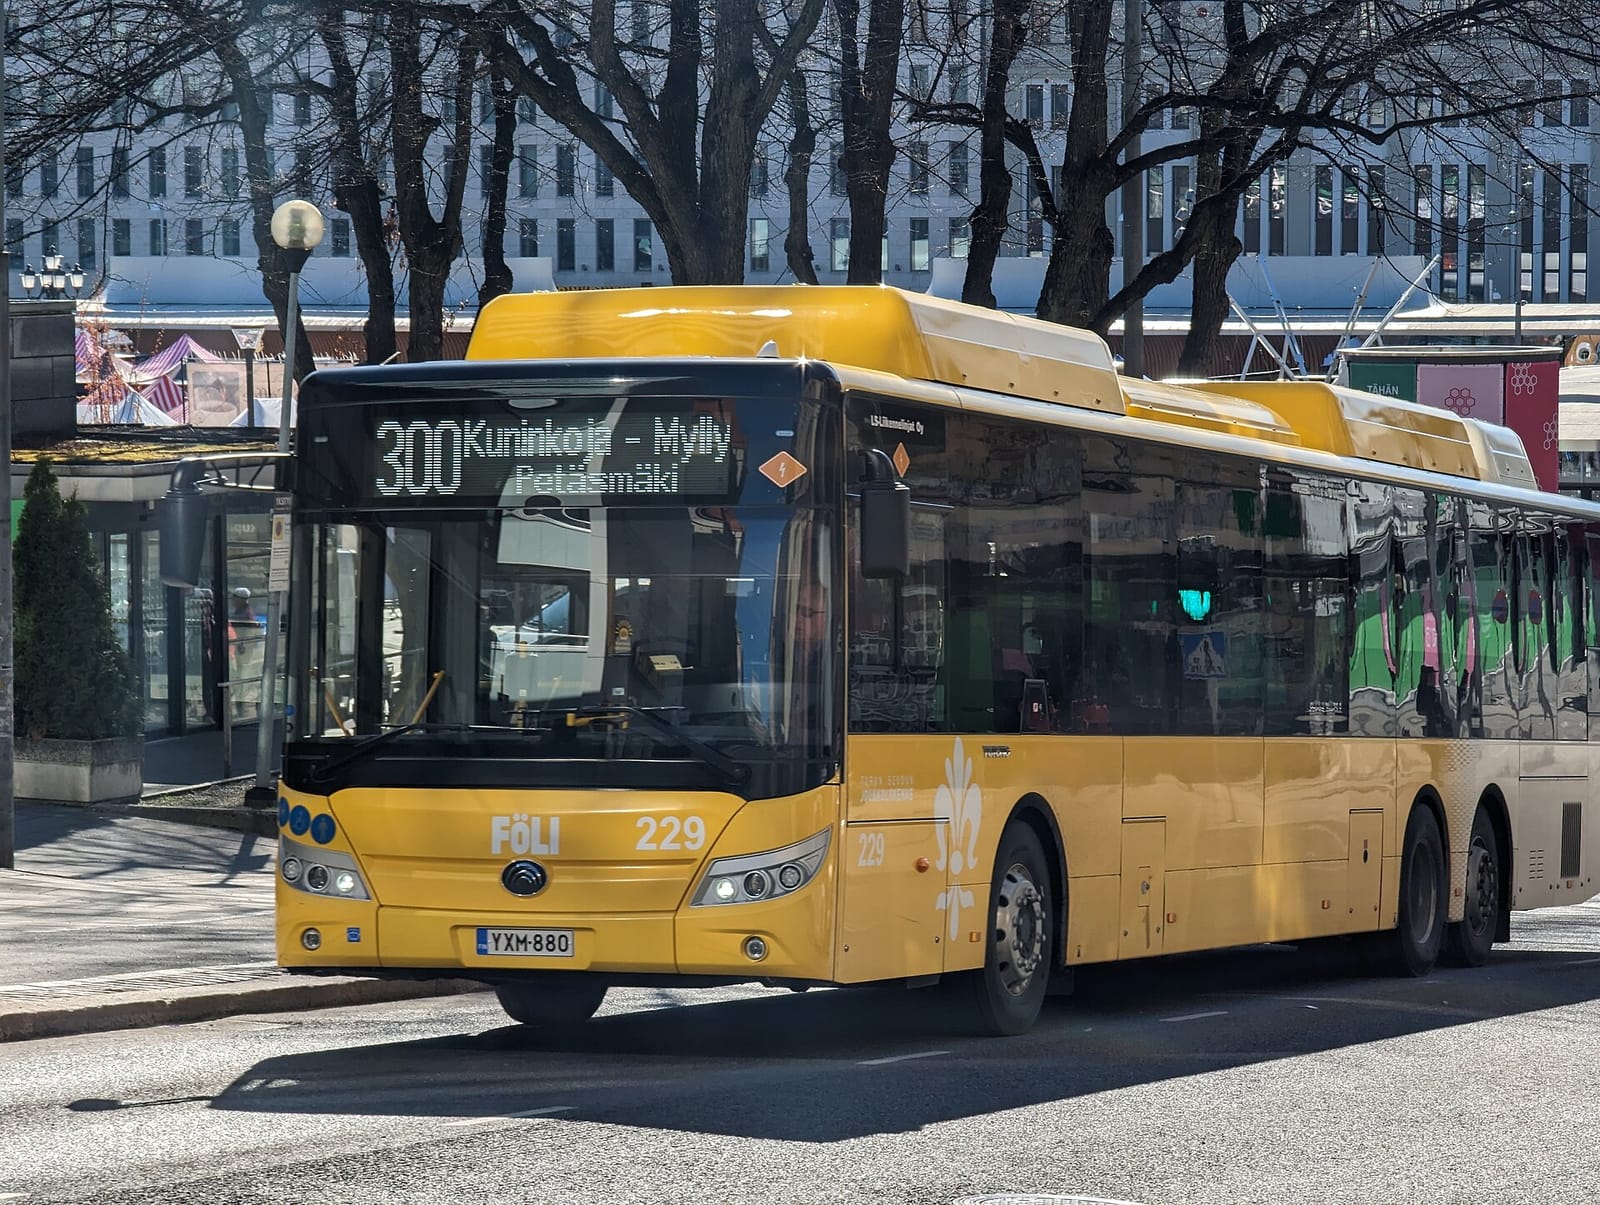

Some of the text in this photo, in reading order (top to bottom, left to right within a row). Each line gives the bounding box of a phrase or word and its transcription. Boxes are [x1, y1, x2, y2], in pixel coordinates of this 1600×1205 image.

[1366, 383, 1399, 396] TÄHÄN
[463, 419, 612, 465] Kuninkoja
[654, 416, 731, 463] Mylly
[376, 420, 463, 496] 300
[515, 463, 679, 494] Petäsmäki
[491, 813, 560, 855] FÖLI
[635, 816, 706, 850] 229
[857, 832, 885, 867] 229
[491, 932, 569, 952] YXM-880
